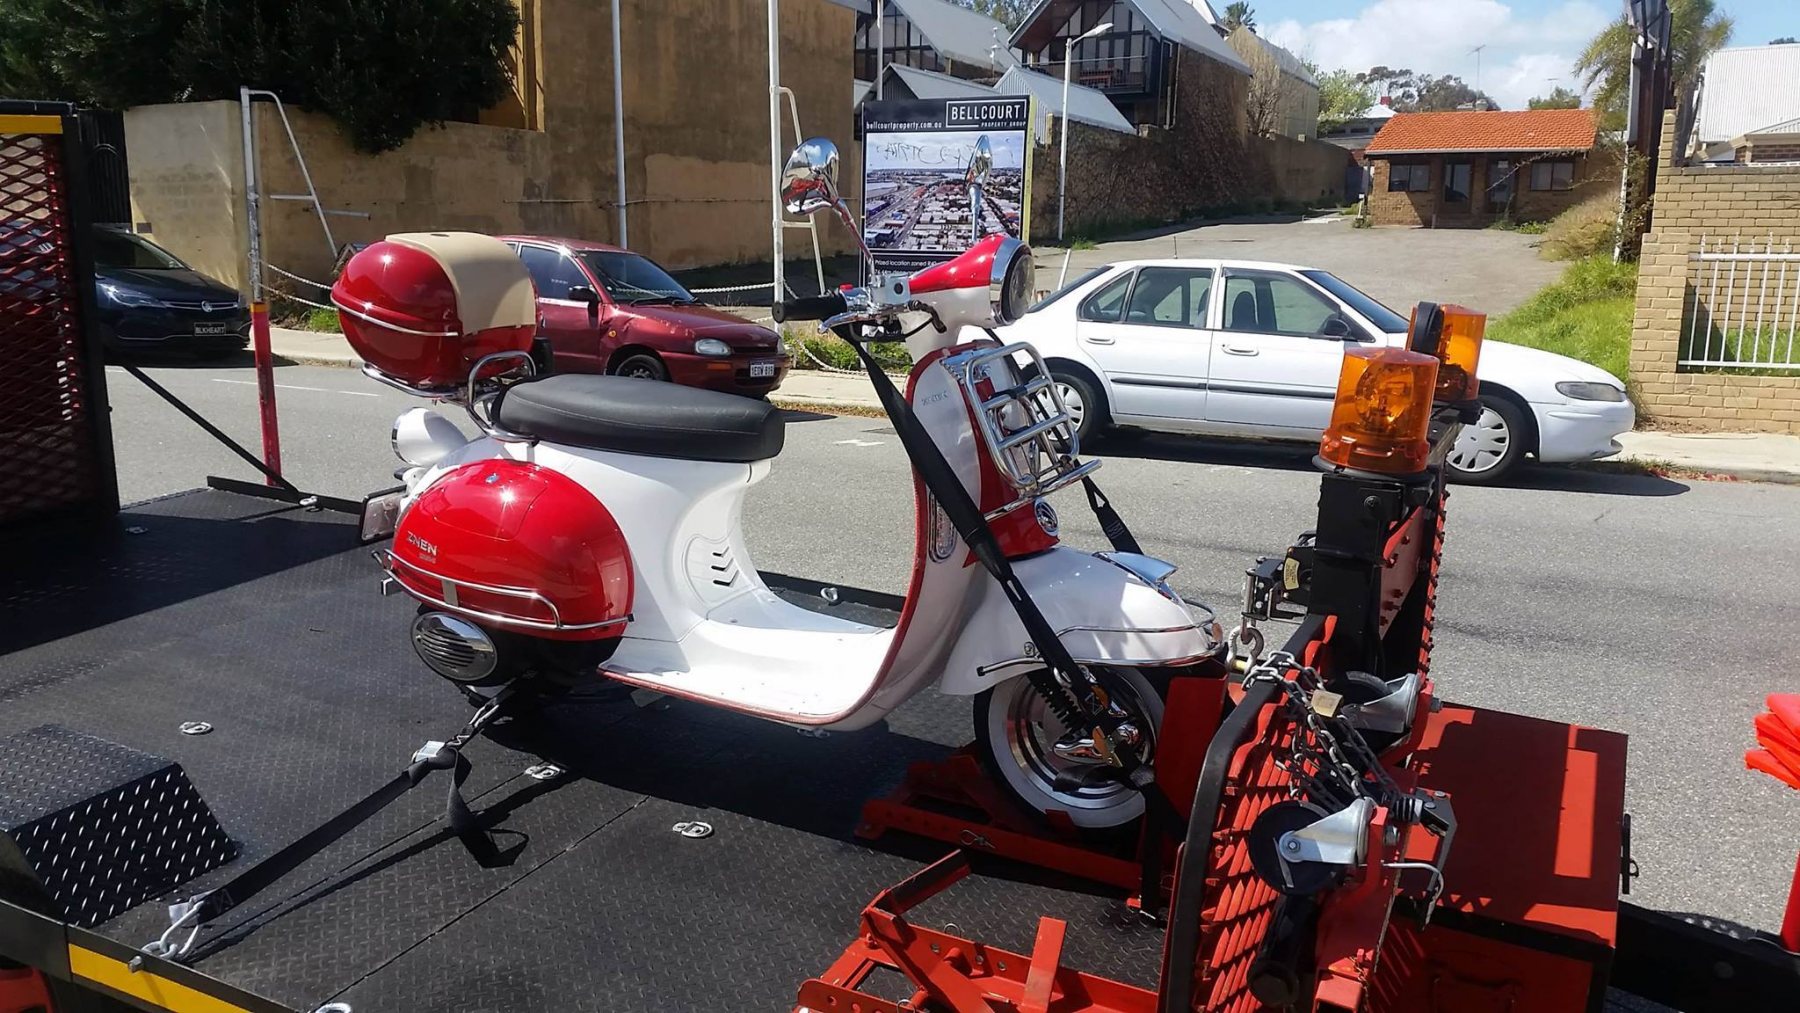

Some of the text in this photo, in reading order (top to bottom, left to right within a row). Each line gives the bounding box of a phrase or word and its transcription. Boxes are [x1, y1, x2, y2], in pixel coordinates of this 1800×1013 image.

[951, 104, 1021, 120] BELLCOURT
[866, 121, 942, 131] bellcourtproperty.com.au
[890, 259, 910, 267] location
[407, 530, 438, 556] ZNEN
